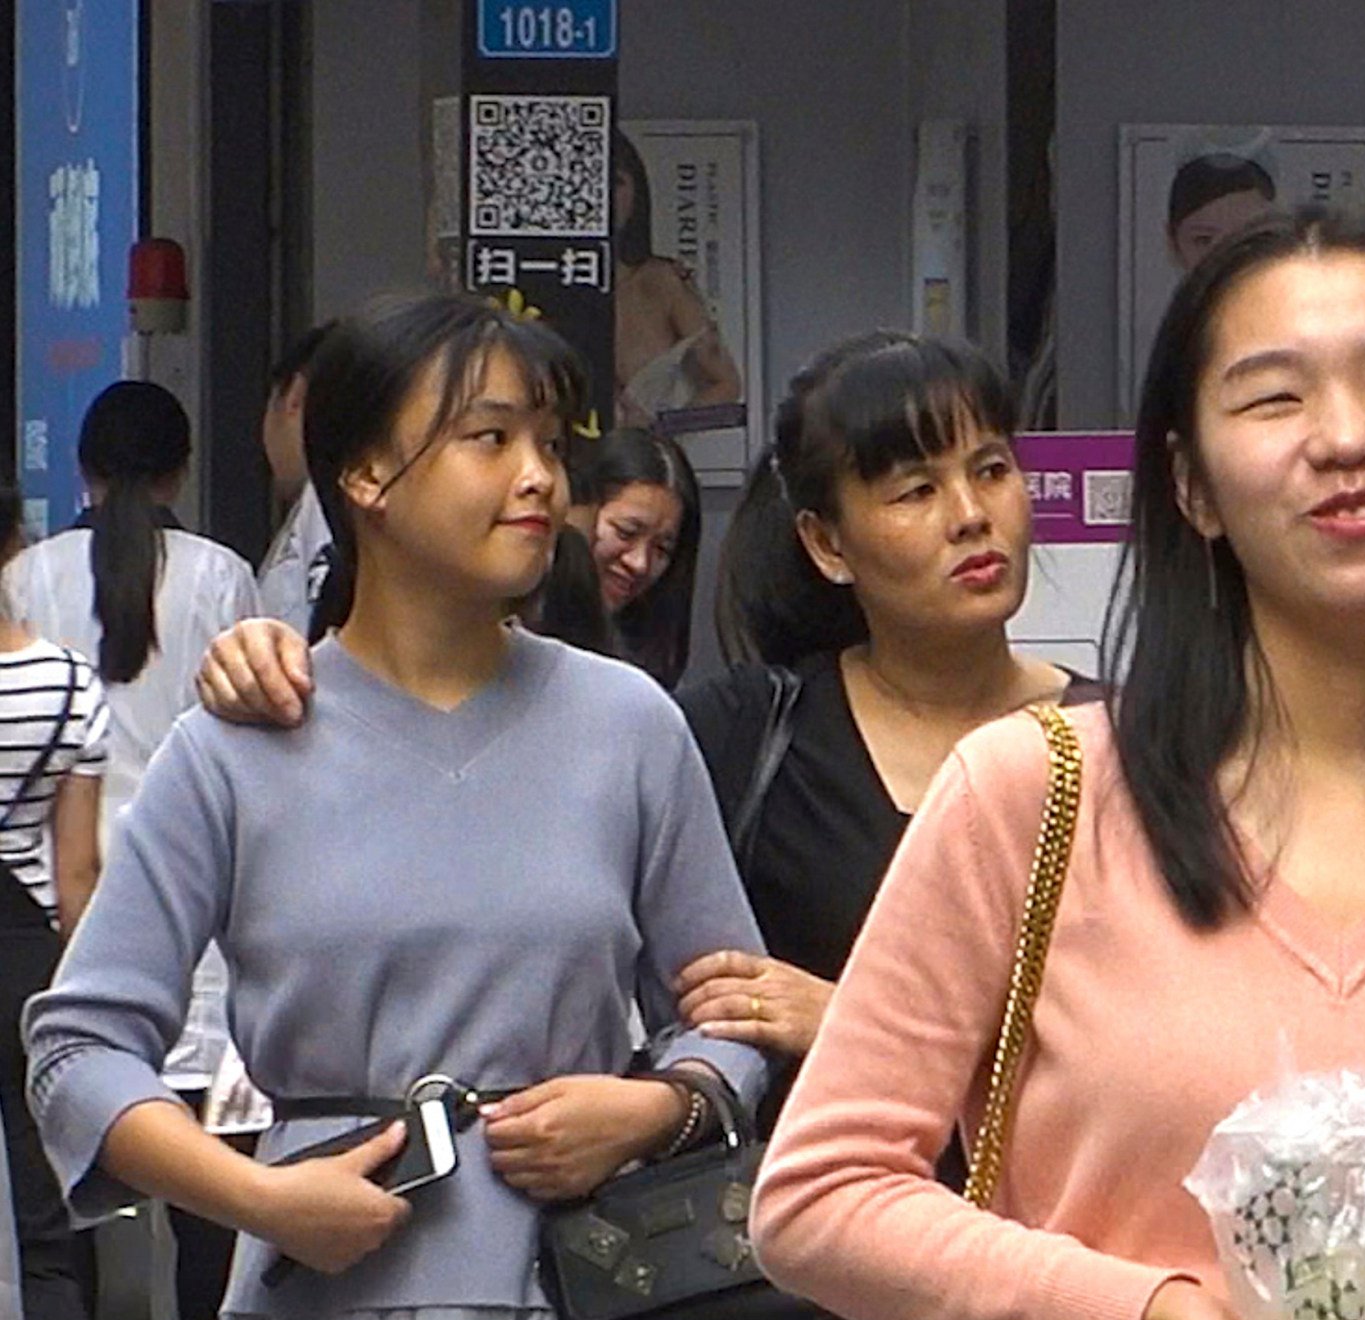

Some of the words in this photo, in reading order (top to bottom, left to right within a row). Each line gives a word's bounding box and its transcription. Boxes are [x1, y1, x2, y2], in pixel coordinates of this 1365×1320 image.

[501, 7, 596, 48] 1018-1
[477, 248, 599, 286] 扫一扫
